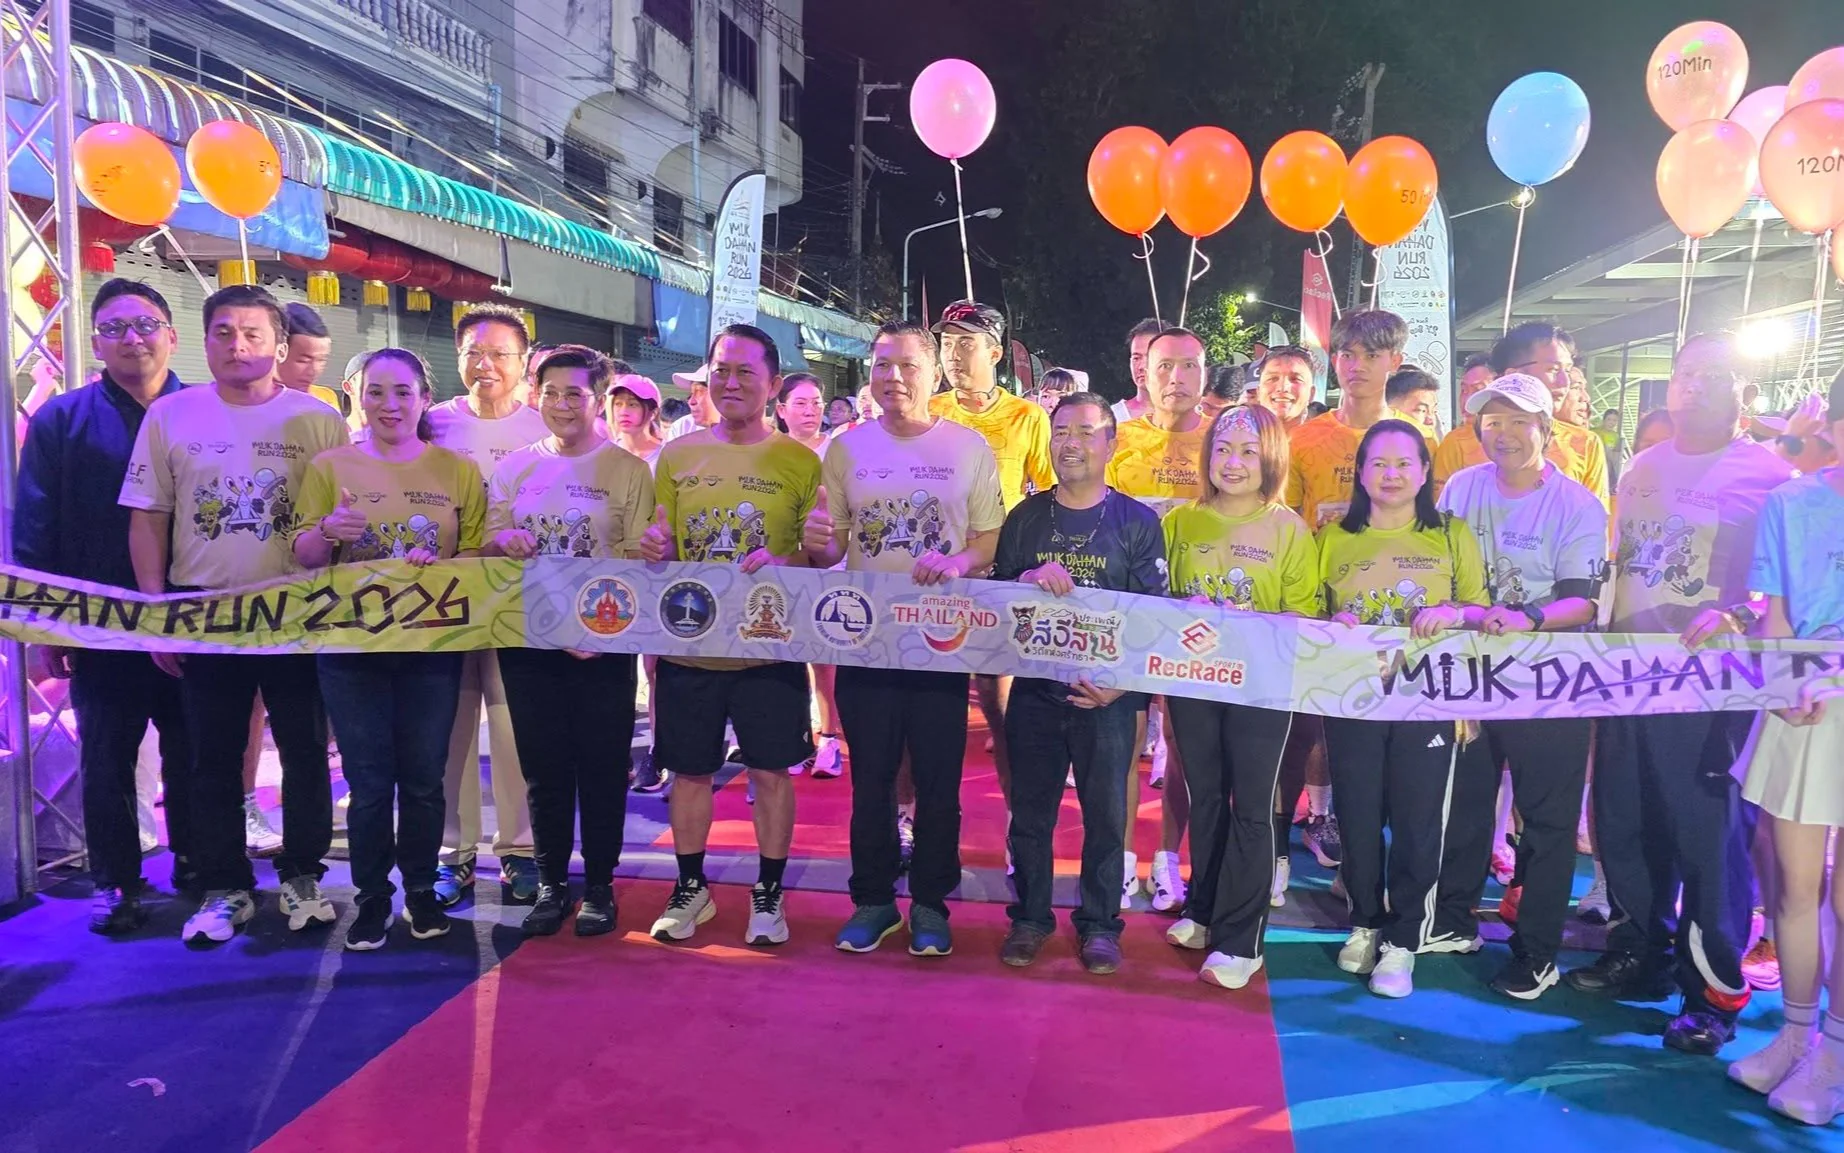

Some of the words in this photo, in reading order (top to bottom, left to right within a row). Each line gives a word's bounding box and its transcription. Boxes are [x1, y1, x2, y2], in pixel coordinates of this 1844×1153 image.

[1657, 57, 1712, 80] 120Min
[729, 222, 751, 238] MUK
[731, 251, 748, 267] RUN
[727, 265, 752, 279] 2026
[162, 590, 289, 634] RUN
[303, 577, 470, 634] 2026
[922, 597, 970, 610] amazing
[894, 606, 997, 628] THAILAND
[1148, 655, 1243, 685] RecRace
